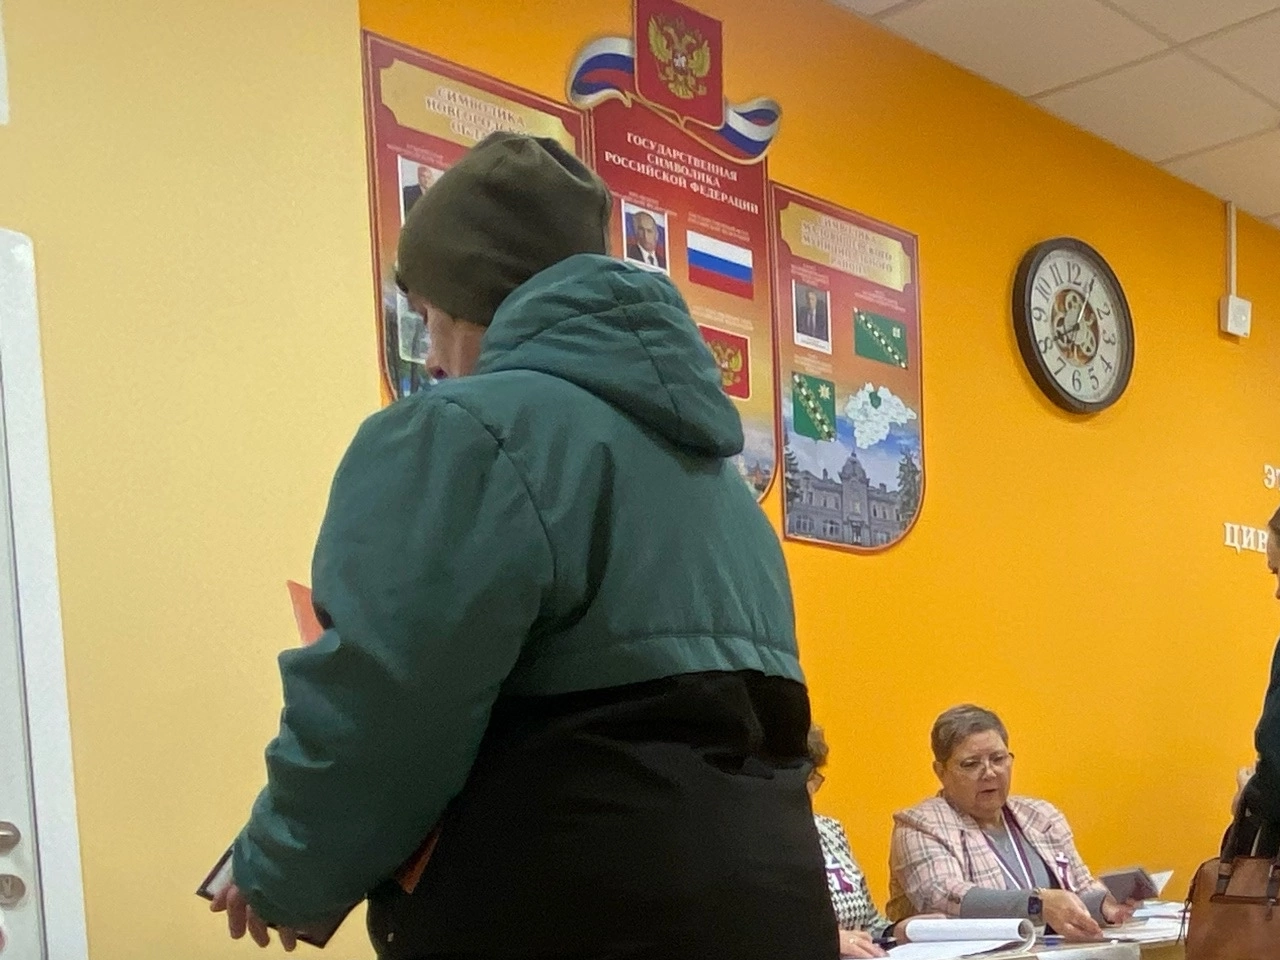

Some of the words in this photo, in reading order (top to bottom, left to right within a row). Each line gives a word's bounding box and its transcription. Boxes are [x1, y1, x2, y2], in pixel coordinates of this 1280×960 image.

[626, 131, 738, 182] ГОСУДАРСТВЕННАЯ
[646, 153, 721, 188] СИМВОЛИКА
[604, 151, 687, 190] РОССИЙСКОЙ
[689, 182, 759, 215] ФЕДЕРАЦИИ
[1049, 261, 1064, 286] 11
[1066, 261, 1082, 286] 12
[1035, 277, 1052, 302] 10
[1033, 306, 1047, 323] 9
[1096, 303, 1111, 321] 2
[1038, 336, 1053, 354] 8
[1103, 329, 1116, 346] 3
[1054, 357, 1067, 376] 7
[1100, 355, 1113, 374] 4
[1072, 369, 1082, 392] 6
[1088, 366, 1099, 390] 5
